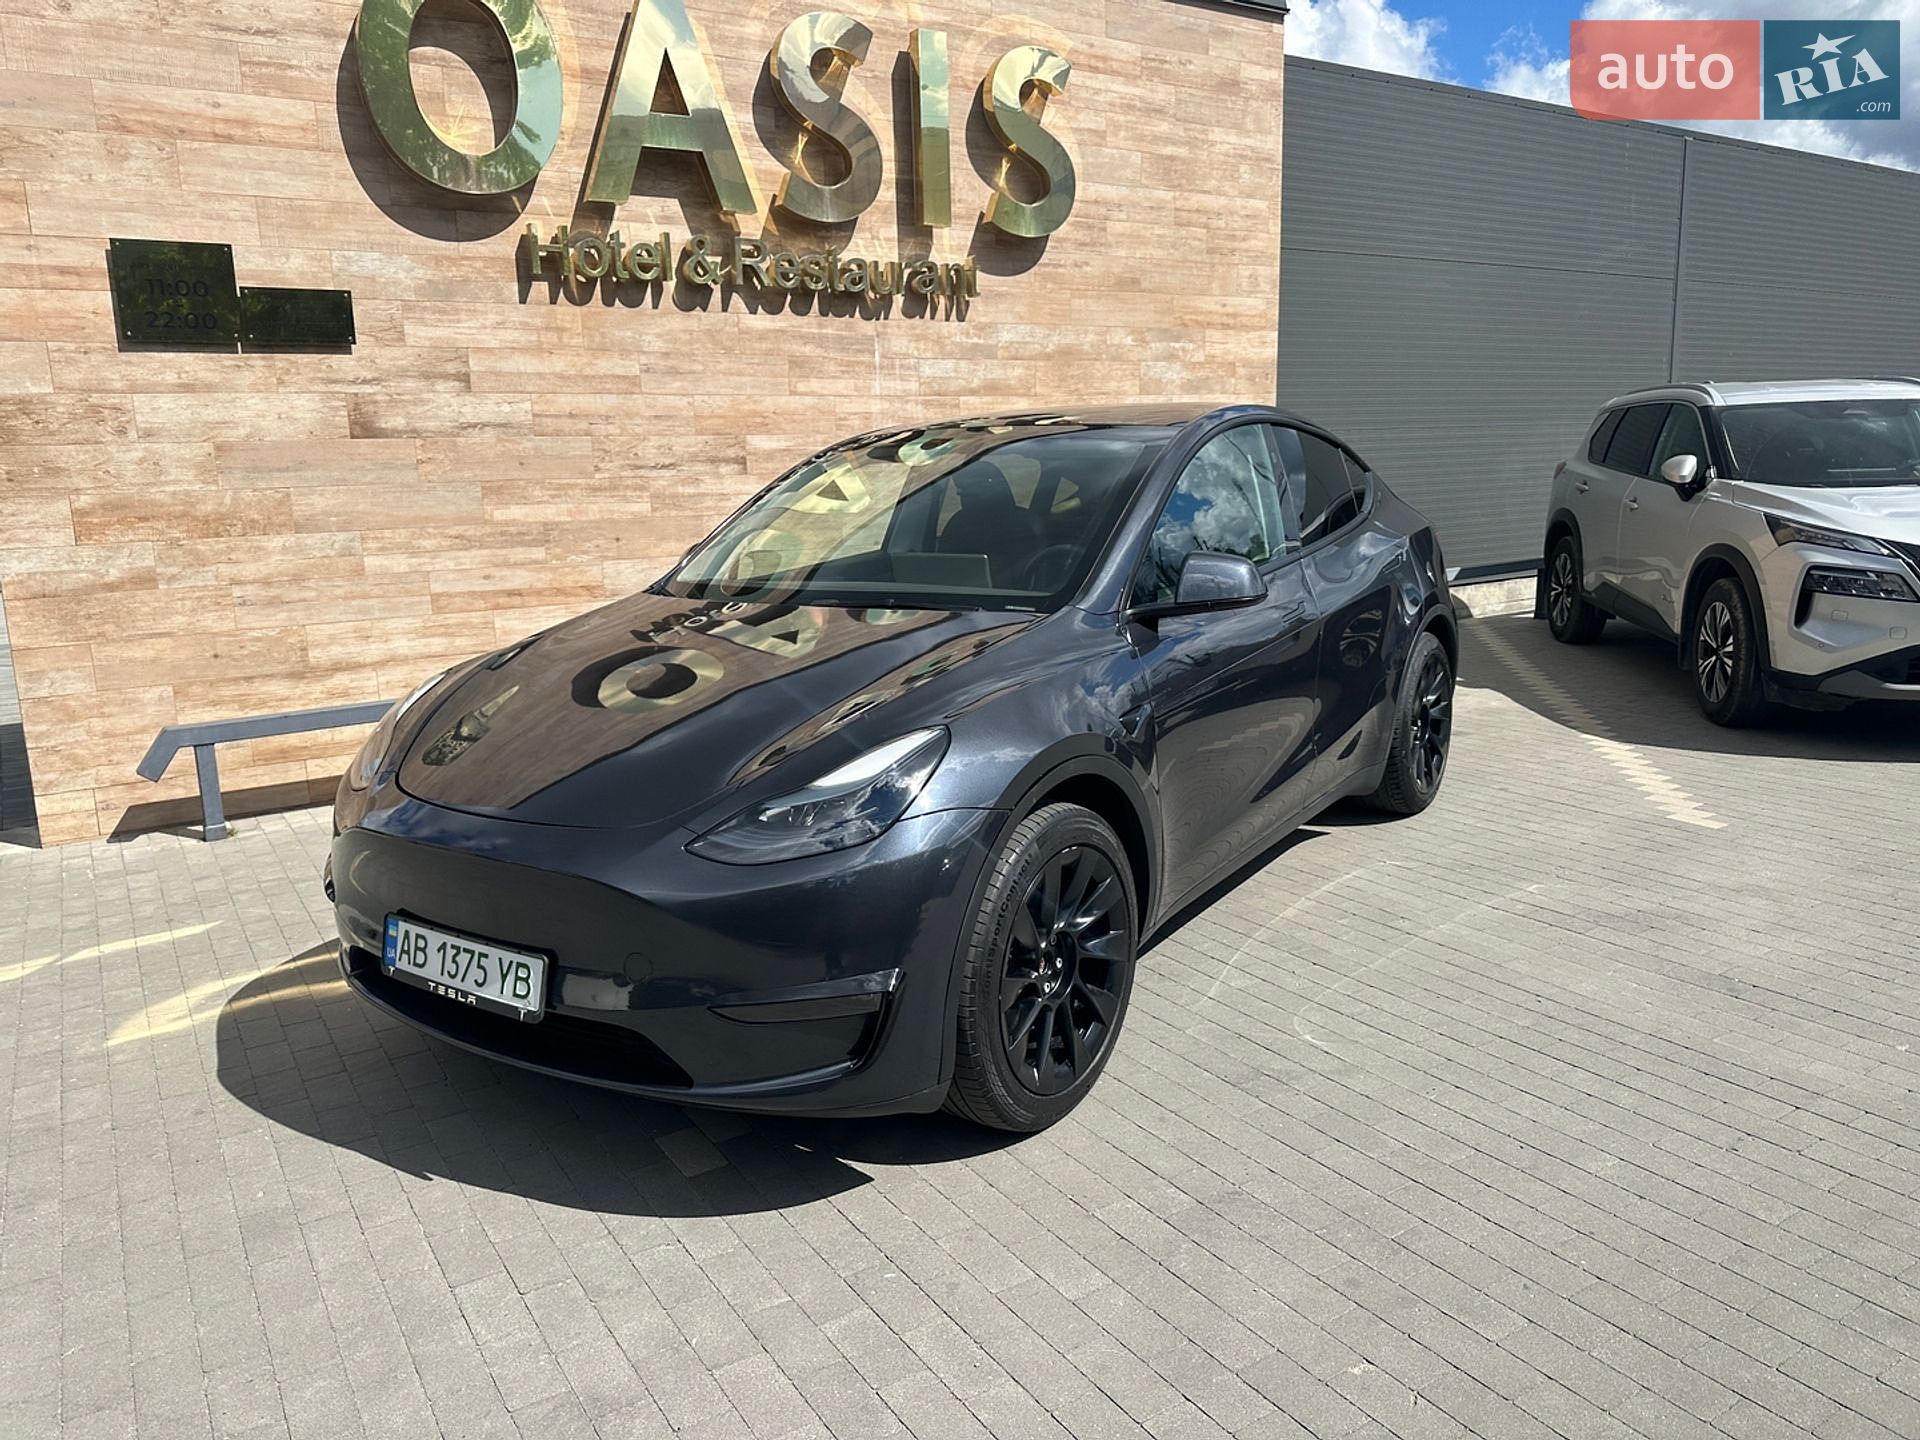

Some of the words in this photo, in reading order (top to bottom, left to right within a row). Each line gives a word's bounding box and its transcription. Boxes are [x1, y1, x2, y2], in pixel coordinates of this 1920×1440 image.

[356, 0, 1076, 237] OASIS
[527, 222, 673, 281] Hotel
[684, 235, 724, 285] &
[735, 237, 979, 298] Restaurant
[144, 278, 209, 298] 11:00
[144, 312, 218, 330] 22:00
[399, 930, 428, 968] AB
[437, 941, 489, 987] 1375
[498, 957, 532, 999] YB
[428, 982, 477, 1005] TESLA
